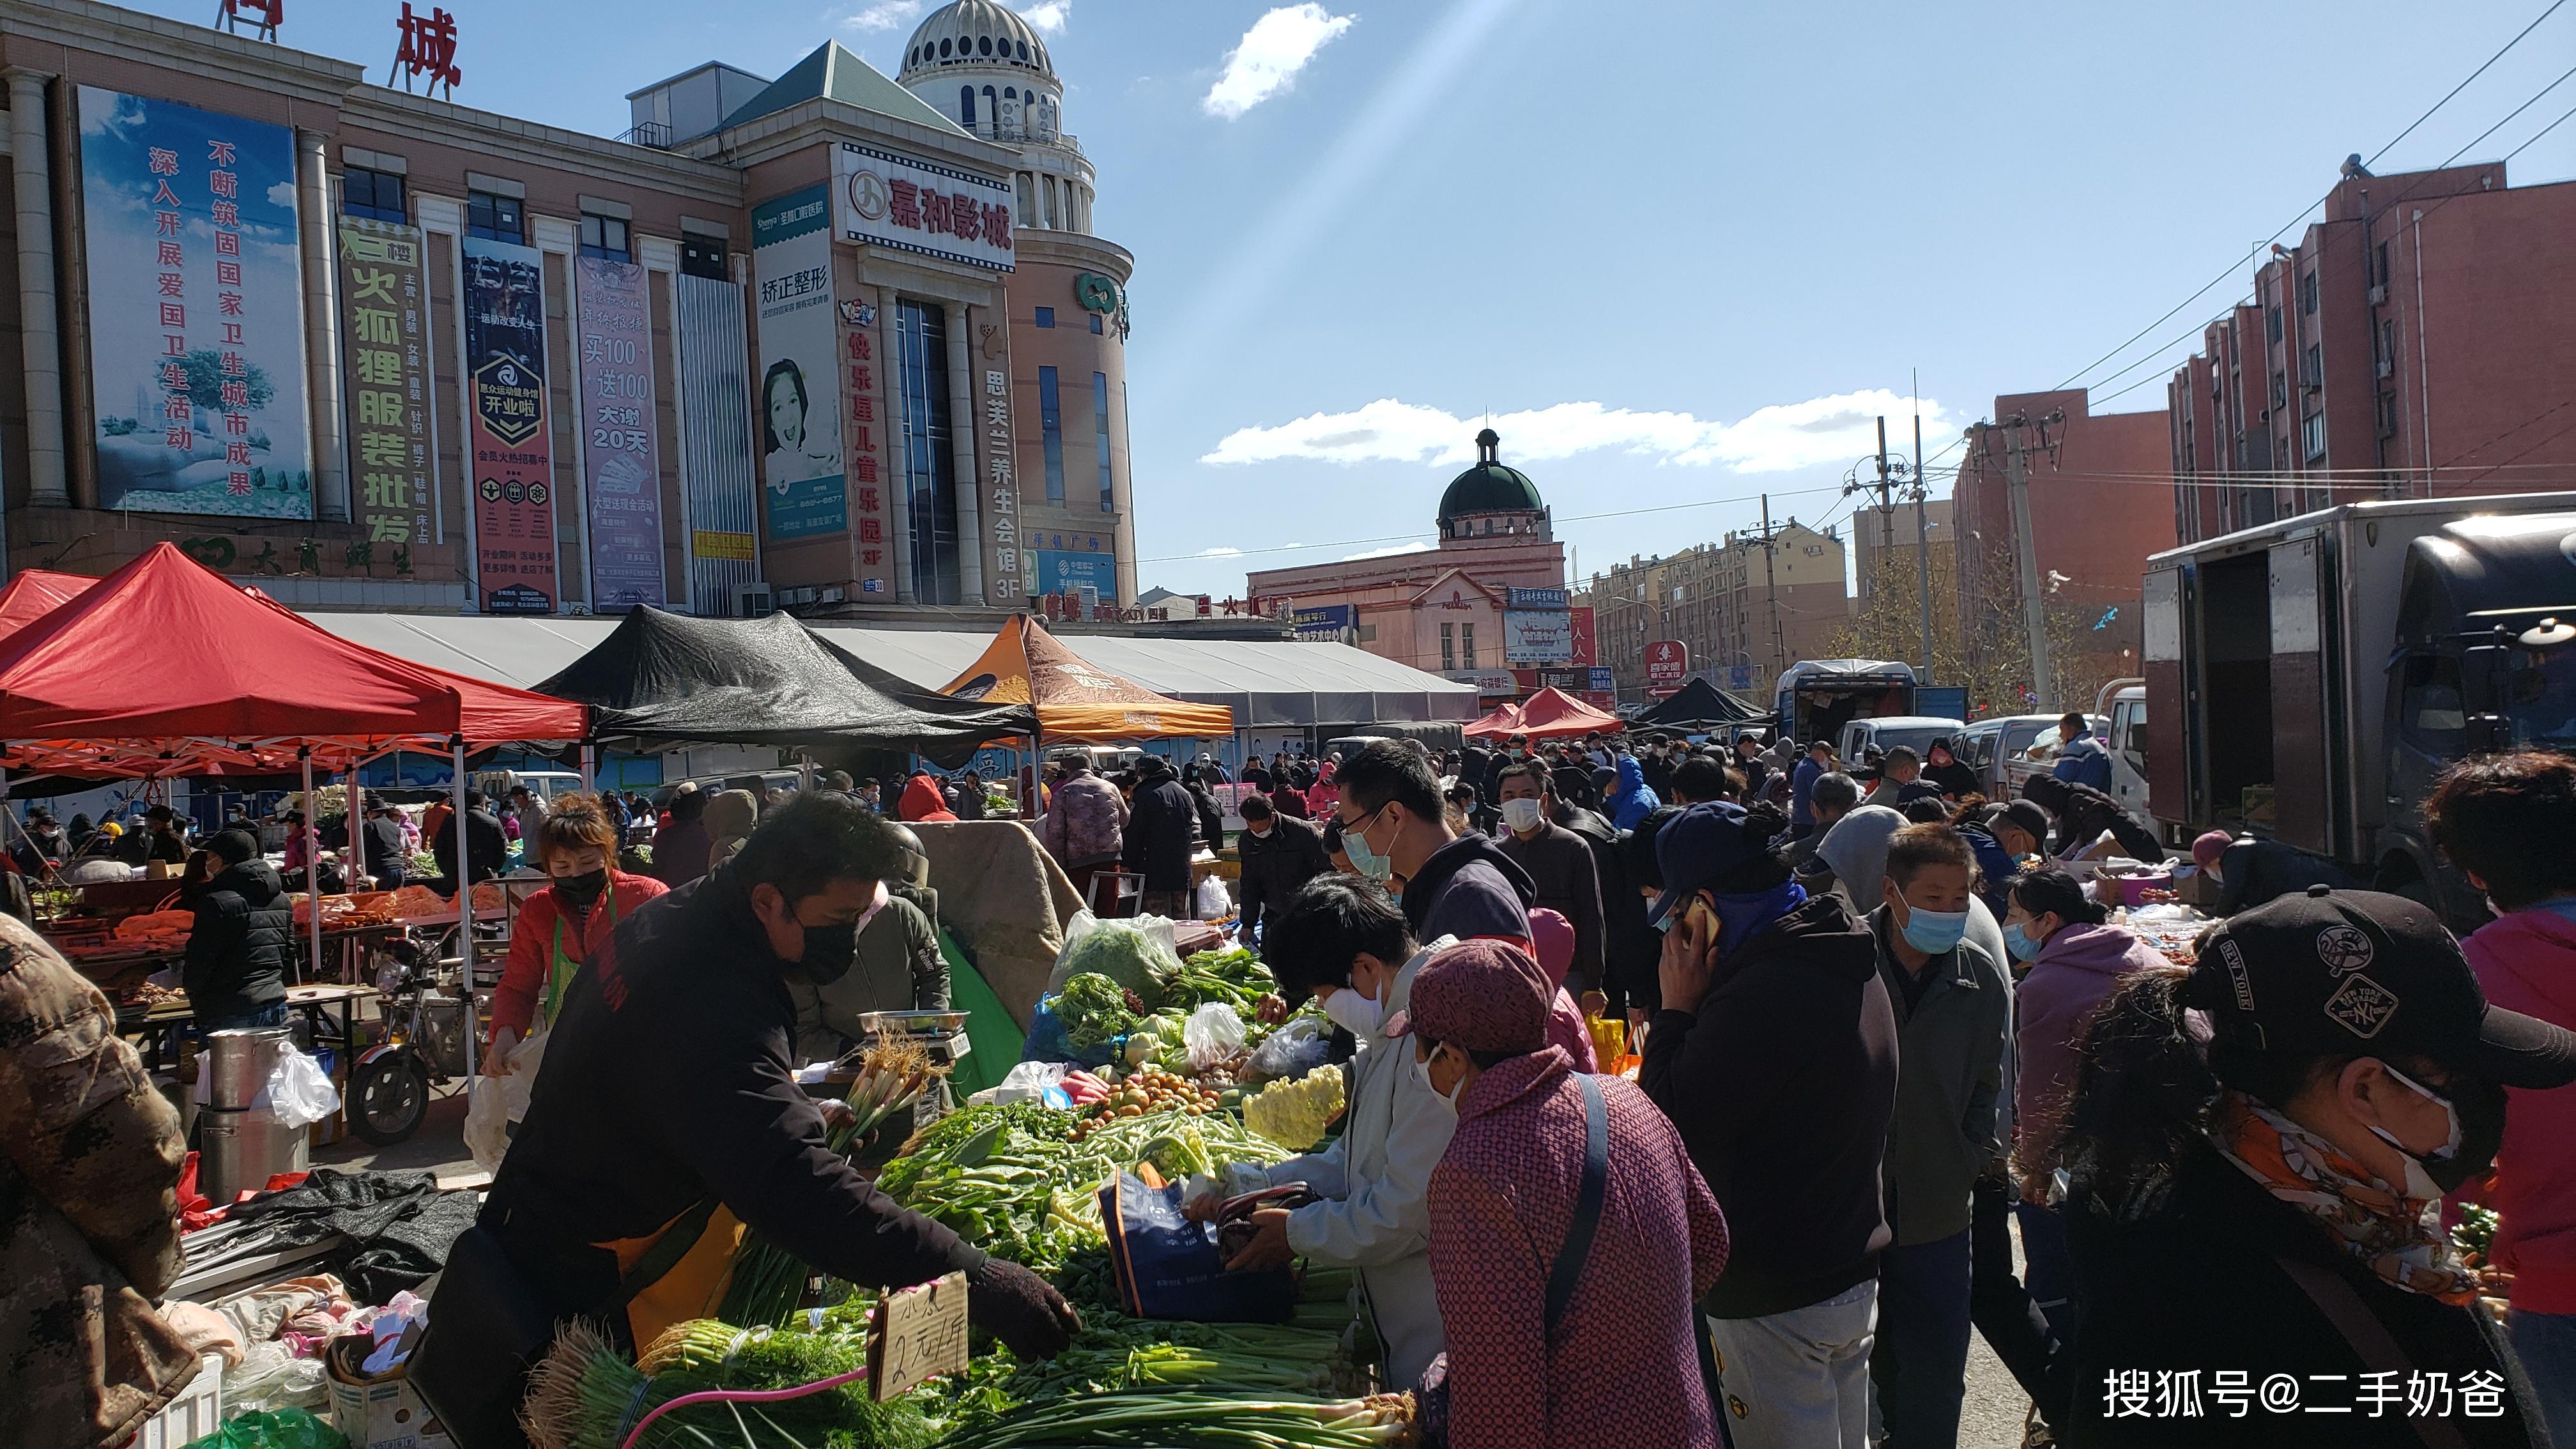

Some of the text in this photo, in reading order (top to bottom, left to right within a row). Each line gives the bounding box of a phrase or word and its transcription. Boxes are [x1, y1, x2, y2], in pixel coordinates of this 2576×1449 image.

[889, 180, 1012, 250] 嘉和影城
[358, 237, 411, 263] 二楼
[762, 264, 827, 305] 矫正整形
[149, 146, 192, 452] 深入开展爱国卫生活动
[207, 140, 253, 496] 不断筑固国家卫生城市成果
[480, 312, 536, 330] 运动改变人生
[582, 307, 646, 334] 年终报捷
[585, 333, 636, 365] 买100
[480, 383, 539, 399] 惠众运动健身馆
[597, 368, 648, 399] 送100
[352, 268, 410, 543] 火狐狸服装批发
[485, 396, 536, 417] 开业啦
[597, 405, 641, 427] 大谢
[593, 429, 649, 454] 20天
[478, 449, 548, 466] 会员火热招募中
[594, 495, 654, 512] 大型送现金活动
[1023, 532, 1100, 551] 手机广场
[876, 581, 882, 590] 30
[1650, 661, 1680, 672] 喜家德
[1477, 677, 1508, 689] 农商银行
[2223, 942, 2251, 1008] NEW YORK
[2338, 987, 2383, 1003] NEW YORK
